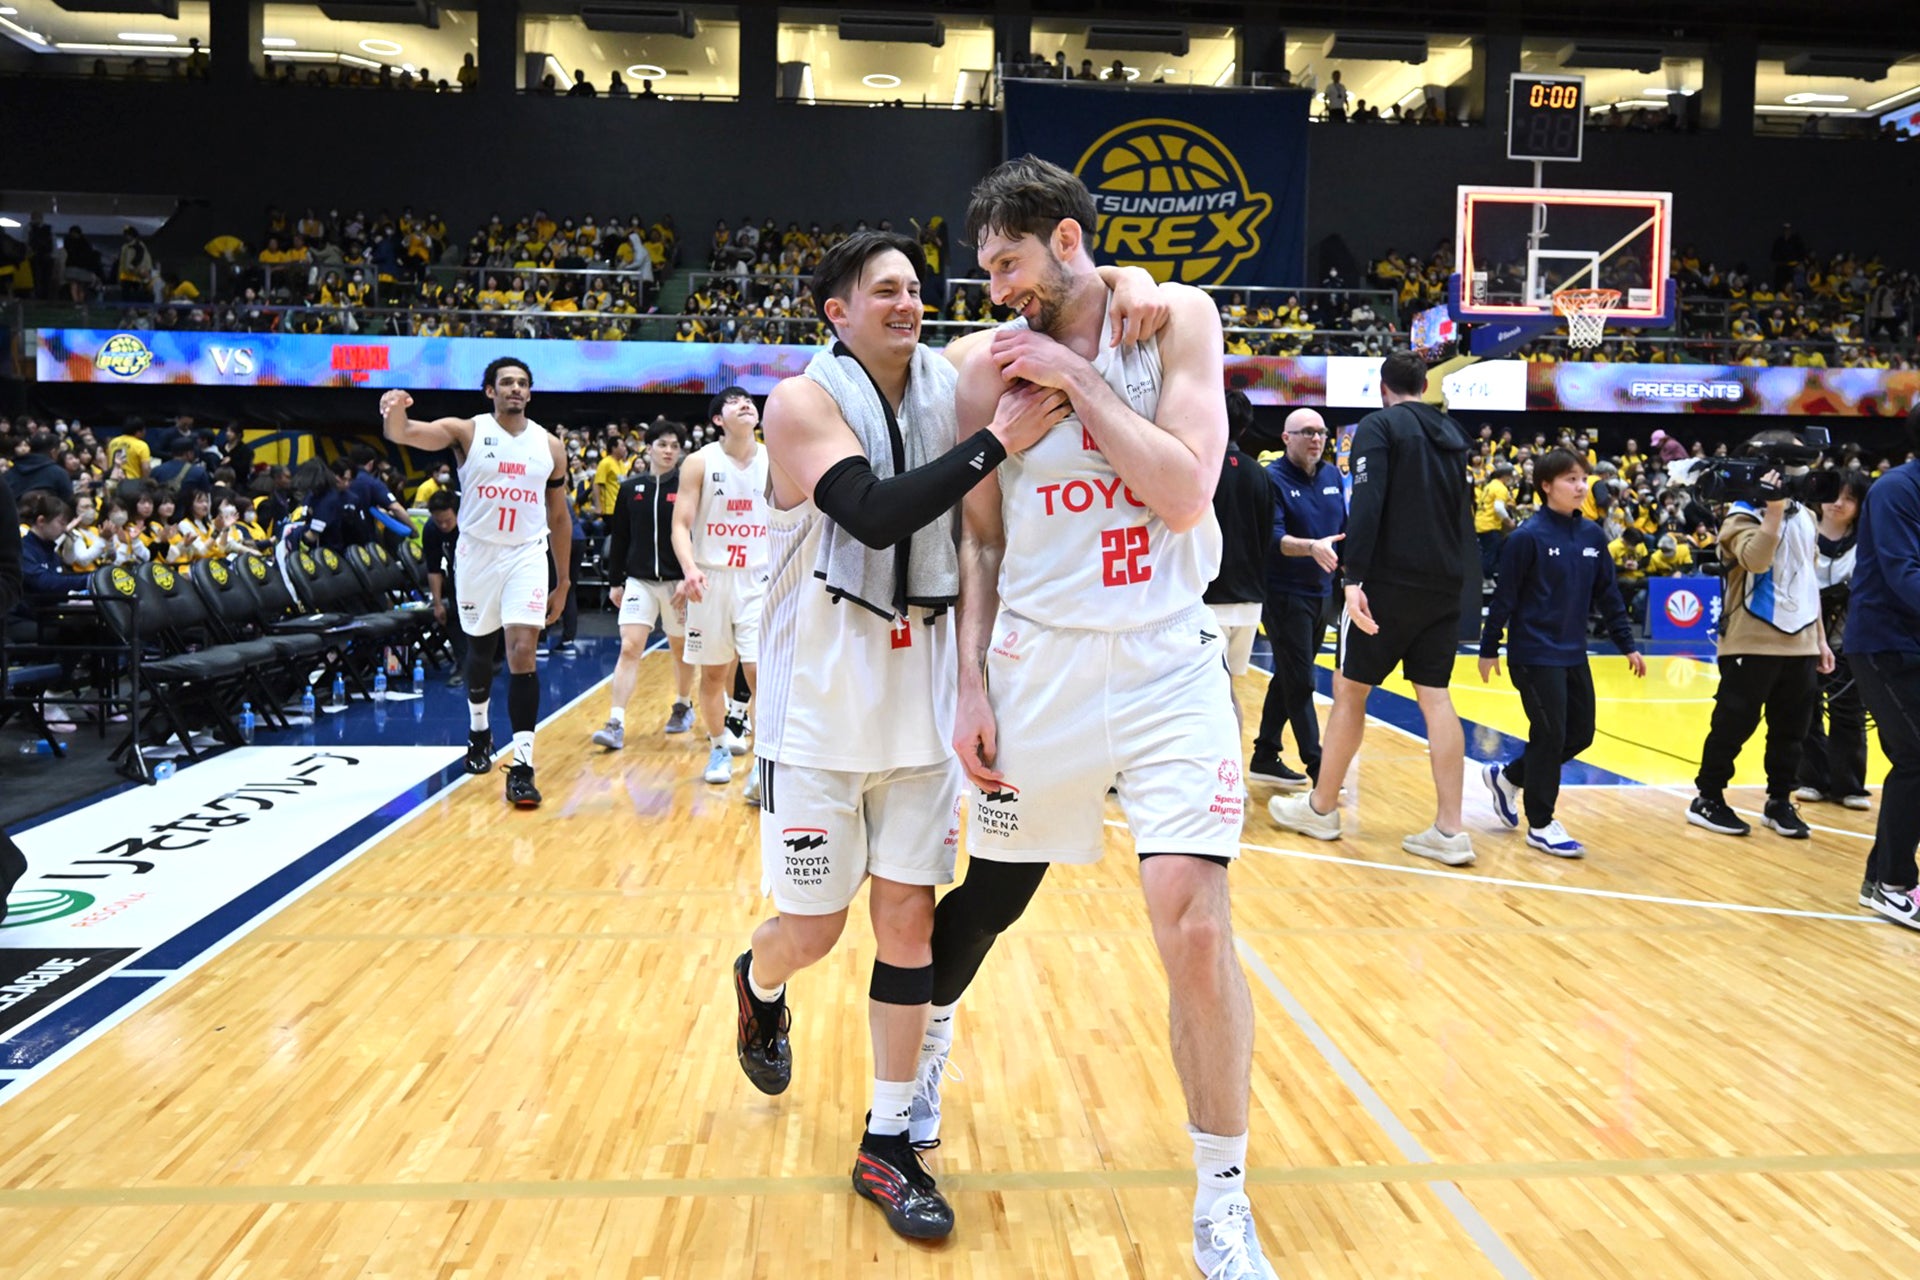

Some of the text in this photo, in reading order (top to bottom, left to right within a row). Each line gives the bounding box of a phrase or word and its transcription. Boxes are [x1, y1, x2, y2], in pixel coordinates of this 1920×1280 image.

[1529, 84, 1578, 109] 0:00
[209, 348, 254, 375] VS
[1631, 382, 1741, 399] PRESENTS
[498, 461, 527, 476] ALVARK
[477, 485, 538, 505] TOYOTA
[498, 507, 517, 532] 11
[707, 523, 767, 538] TOYOTA
[727, 545, 747, 568] 75
[1101, 526, 1152, 588] 22
[977, 803, 1019, 822] TOYOTA
[977, 814, 1019, 831] ARENA
[982, 826, 1010, 838] TOKYO
[785, 856, 830, 866] TOYOTA
[785, 866, 831, 876] ARENA
[793, 878, 822, 886] TOKYO
[70, 890, 150, 928] RESONA
